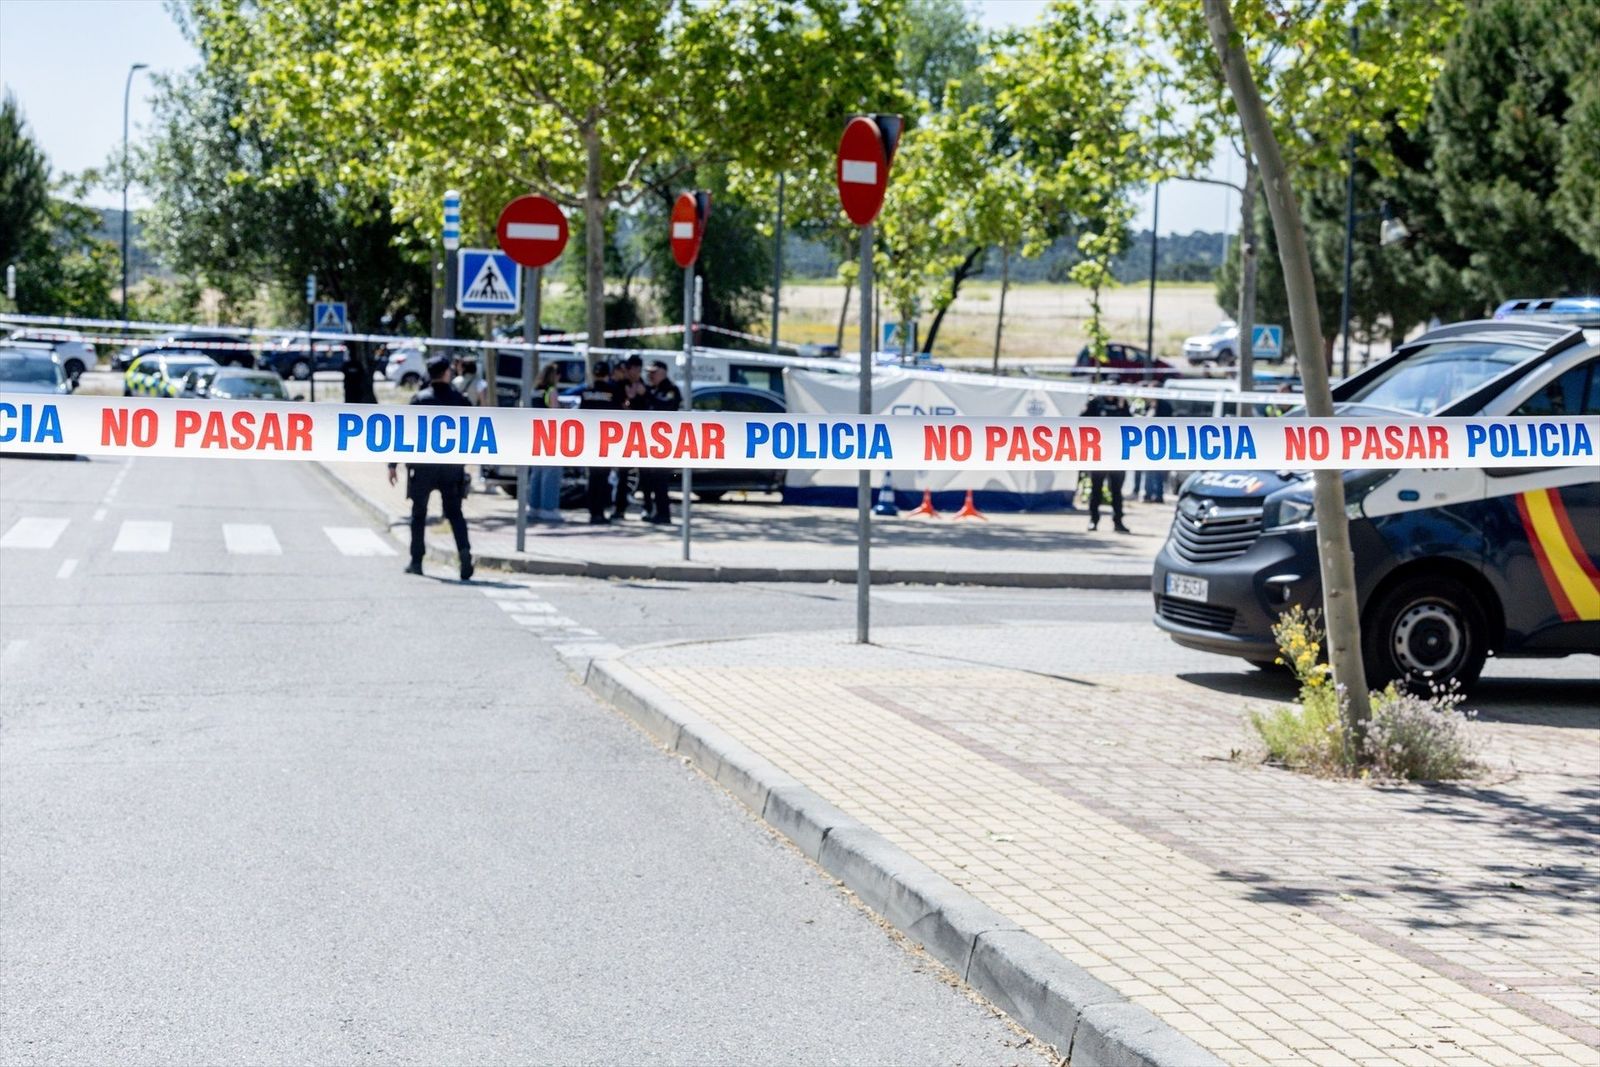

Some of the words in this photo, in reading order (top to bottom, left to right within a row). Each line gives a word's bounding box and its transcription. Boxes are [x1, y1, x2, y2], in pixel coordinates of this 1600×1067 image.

[101, 407, 158, 447] NO
[175, 409, 313, 451] PASAR
[337, 413, 497, 454] POLICIA
[532, 419, 584, 457] NO
[598, 420, 725, 459] PASAR
[745, 422, 893, 459] POLICIA
[924, 425, 972, 461] NO
[985, 426, 1101, 461] PASAR
[1120, 425, 1256, 460] POLICIA
[1285, 426, 1330, 460] NO
[1341, 425, 1449, 460] PASAR
[1466, 422, 1593, 458] POLICIA
